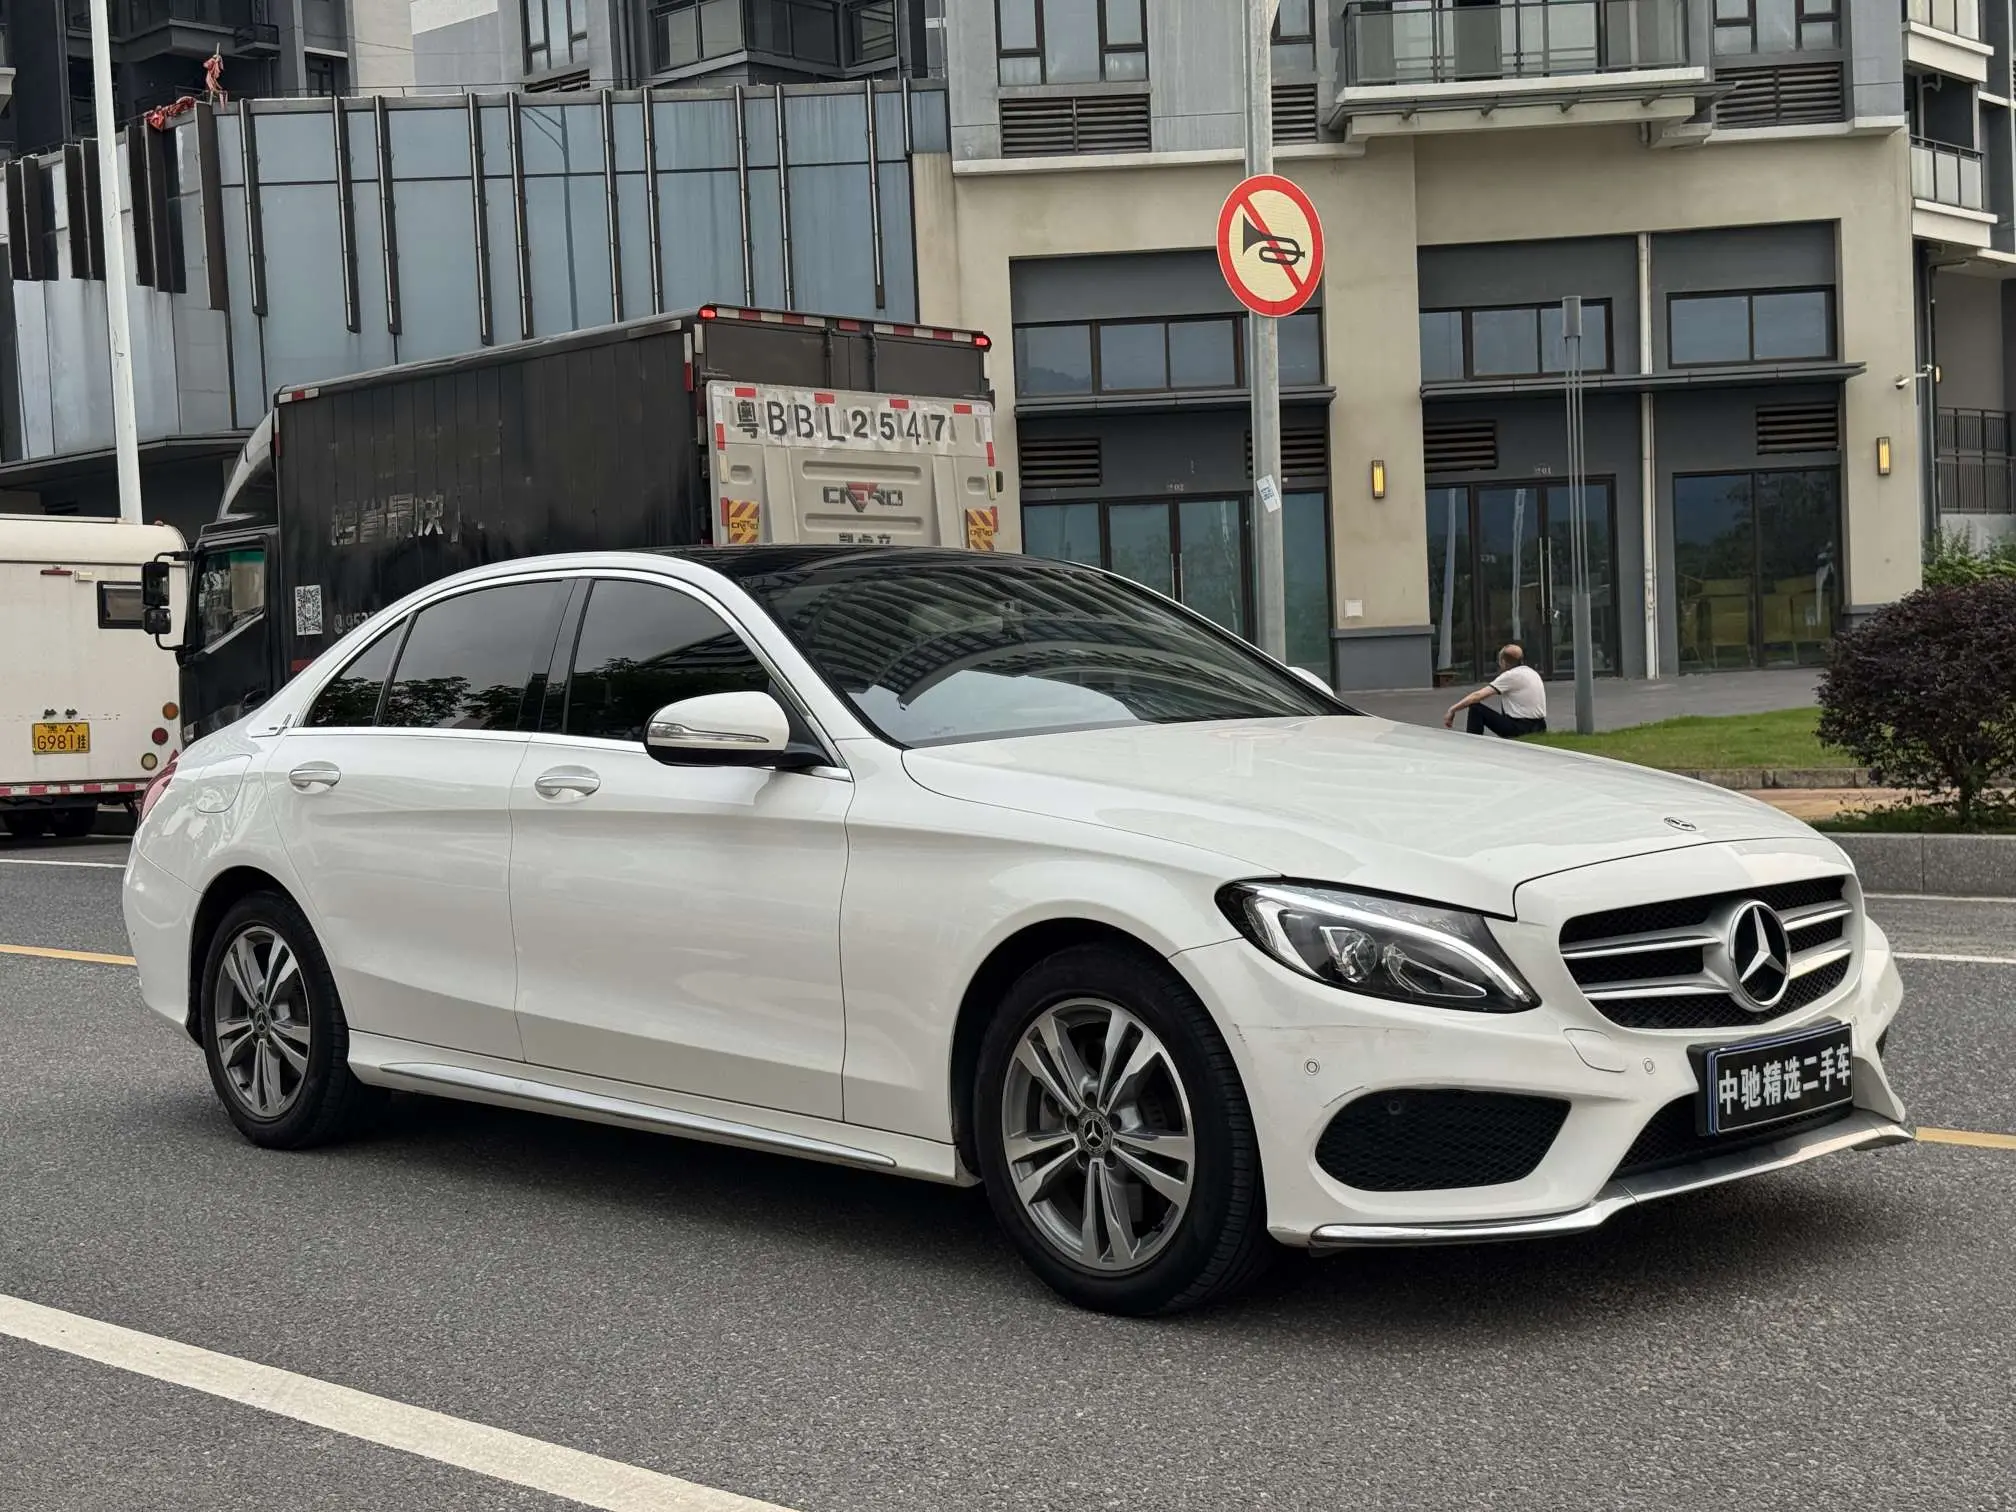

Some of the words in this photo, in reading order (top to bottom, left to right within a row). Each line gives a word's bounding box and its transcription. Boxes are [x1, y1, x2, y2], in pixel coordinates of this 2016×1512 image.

[1718, 1043, 1850, 1114] 中驰精选二手车
